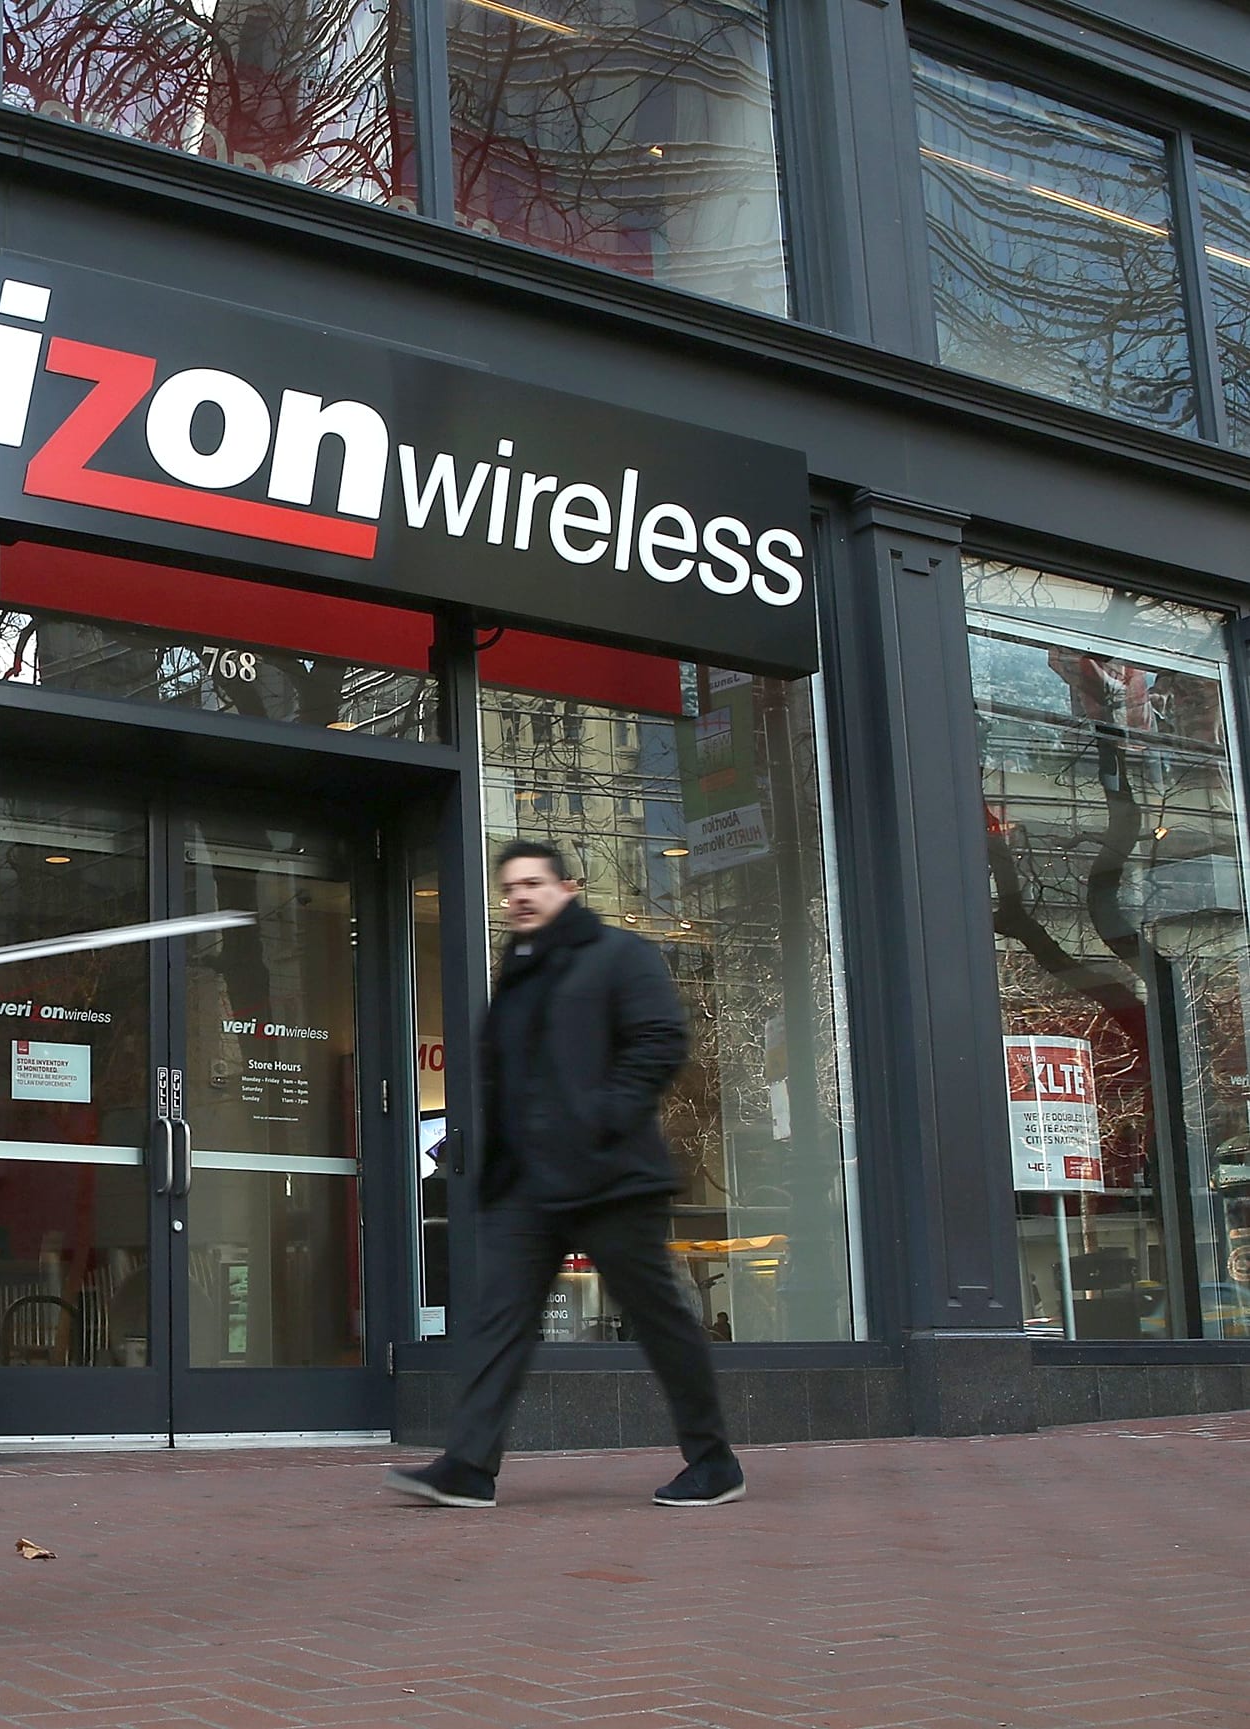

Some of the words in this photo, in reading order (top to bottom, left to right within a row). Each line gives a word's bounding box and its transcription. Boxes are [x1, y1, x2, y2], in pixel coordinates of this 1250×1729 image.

[398, 437, 805, 606] wireless
[201, 645, 257, 682] 768
[64, 1008, 112, 1023] wireless
[222, 1018, 286, 1040] verizon
[285, 1026, 329, 1040] wireless
[36, 1059, 69, 1067] INVENTORY
[248, 1059, 273, 1070] Store
[274, 1061, 301, 1072] Hours
[1024, 1124, 1037, 1133] 4G
